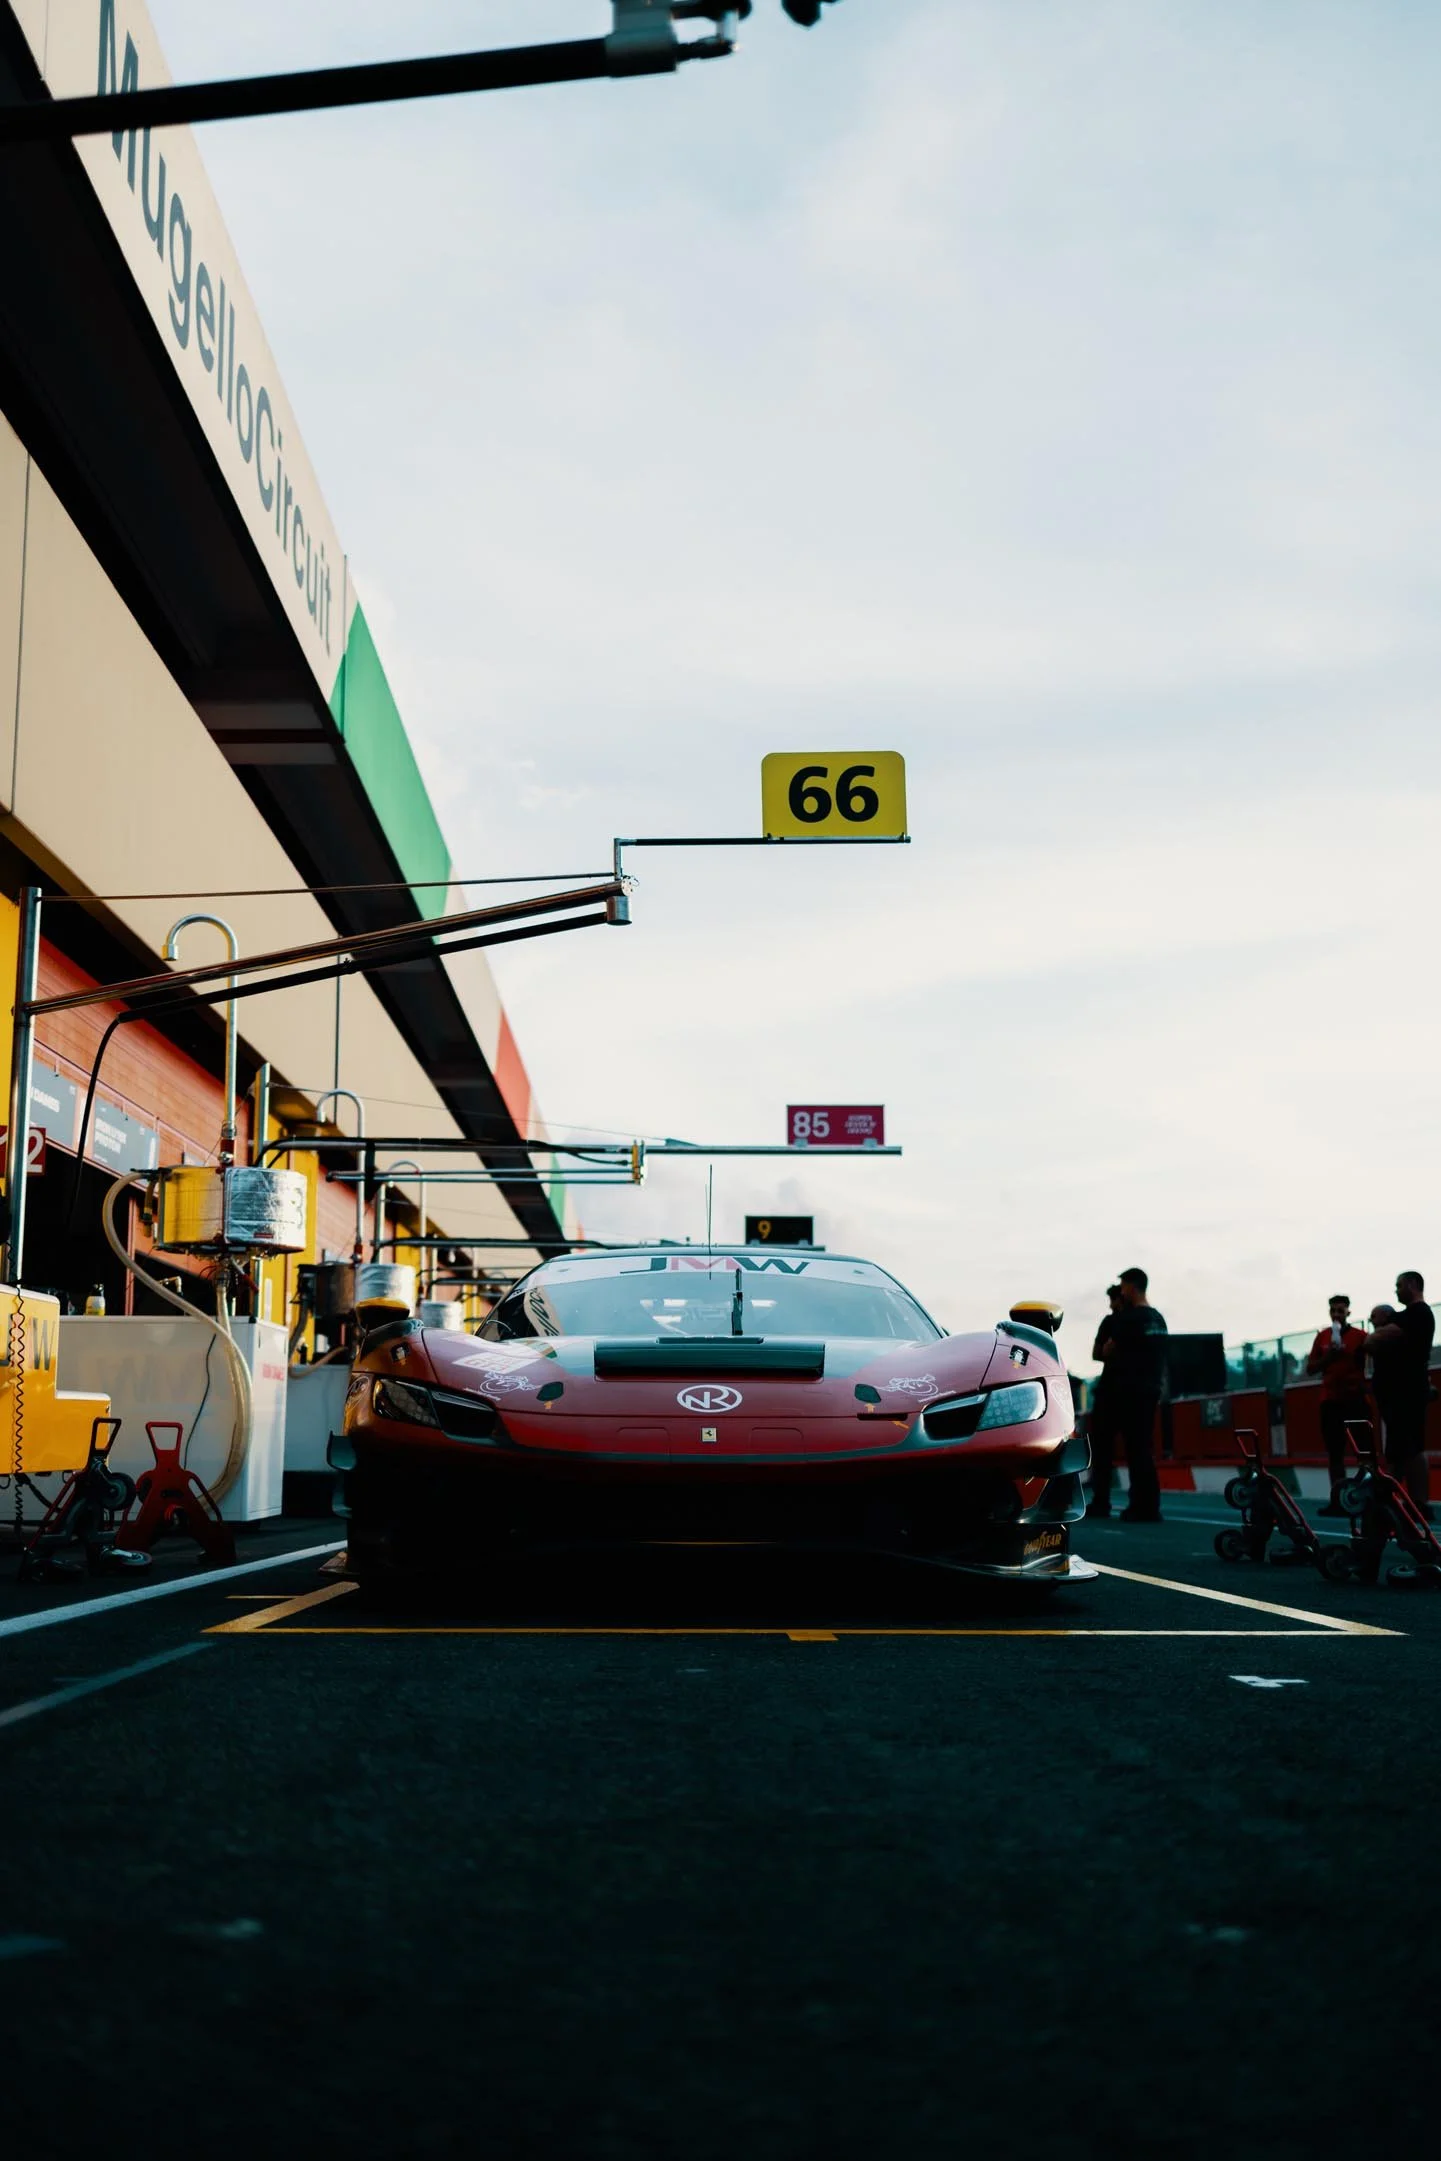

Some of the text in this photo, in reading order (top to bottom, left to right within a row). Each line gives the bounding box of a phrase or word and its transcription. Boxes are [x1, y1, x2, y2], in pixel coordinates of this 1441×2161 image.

[788, 765, 879, 823] 66
[793, 1111, 830, 1138] 85
[757, 1220, 772, 1239] 9
[620, 1257, 810, 1275] JMW
